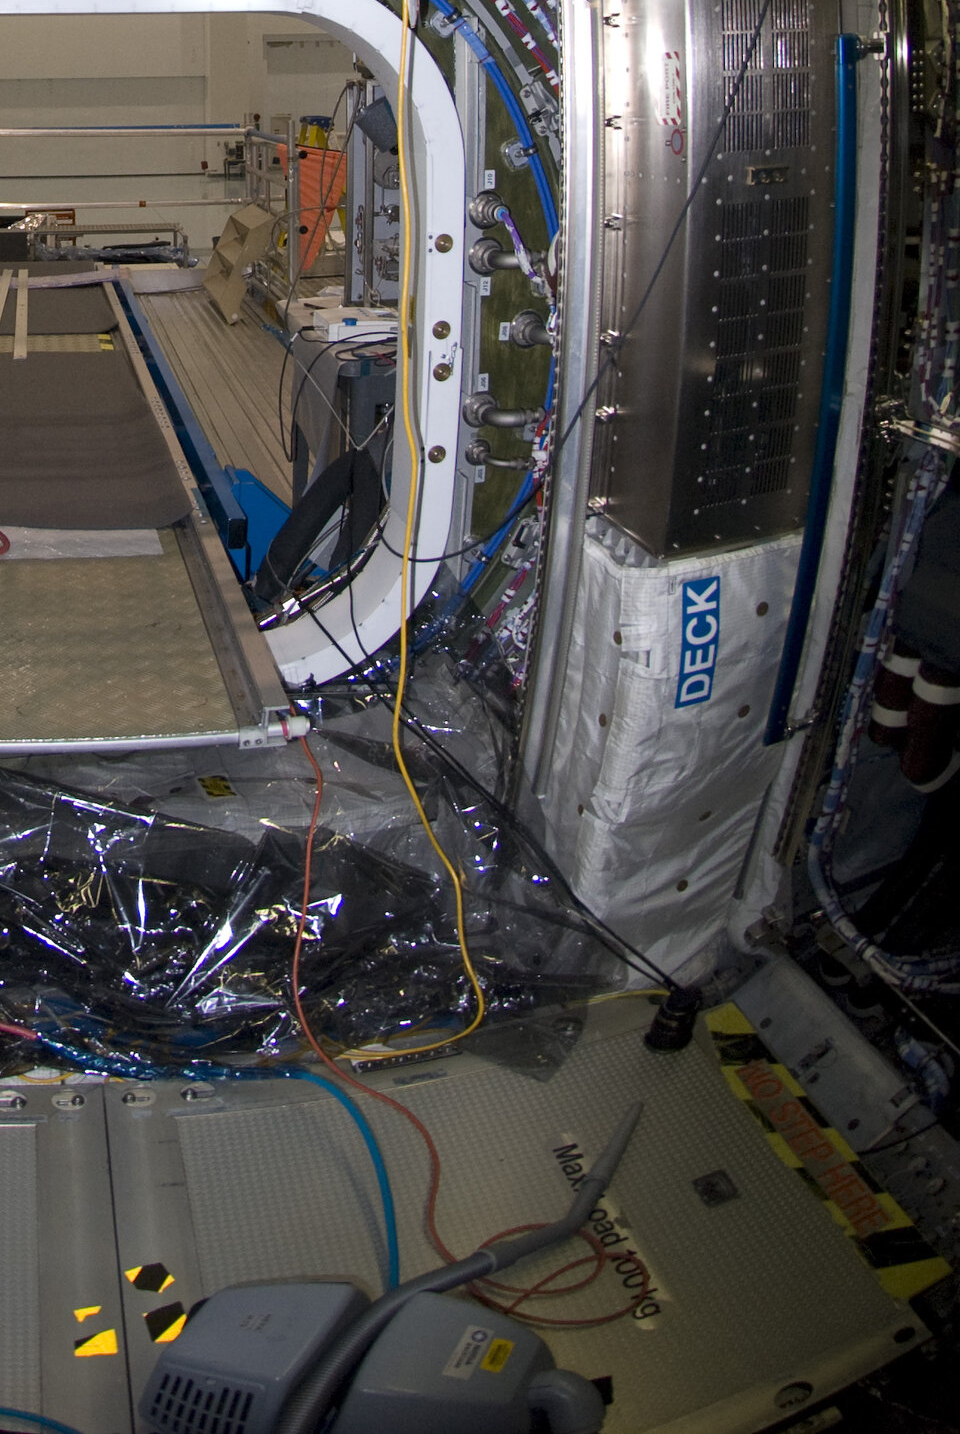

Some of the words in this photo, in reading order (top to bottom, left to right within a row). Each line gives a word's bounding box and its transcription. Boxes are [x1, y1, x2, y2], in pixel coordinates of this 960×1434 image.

[680, 582, 718, 703] DECK
[735, 1058, 783, 1100] NO
[770, 1101, 834, 1163] STEP
[818, 1161, 892, 1236] HERE
[589, 1194, 628, 1248] oad
[631, 1286, 661, 1320] kg
